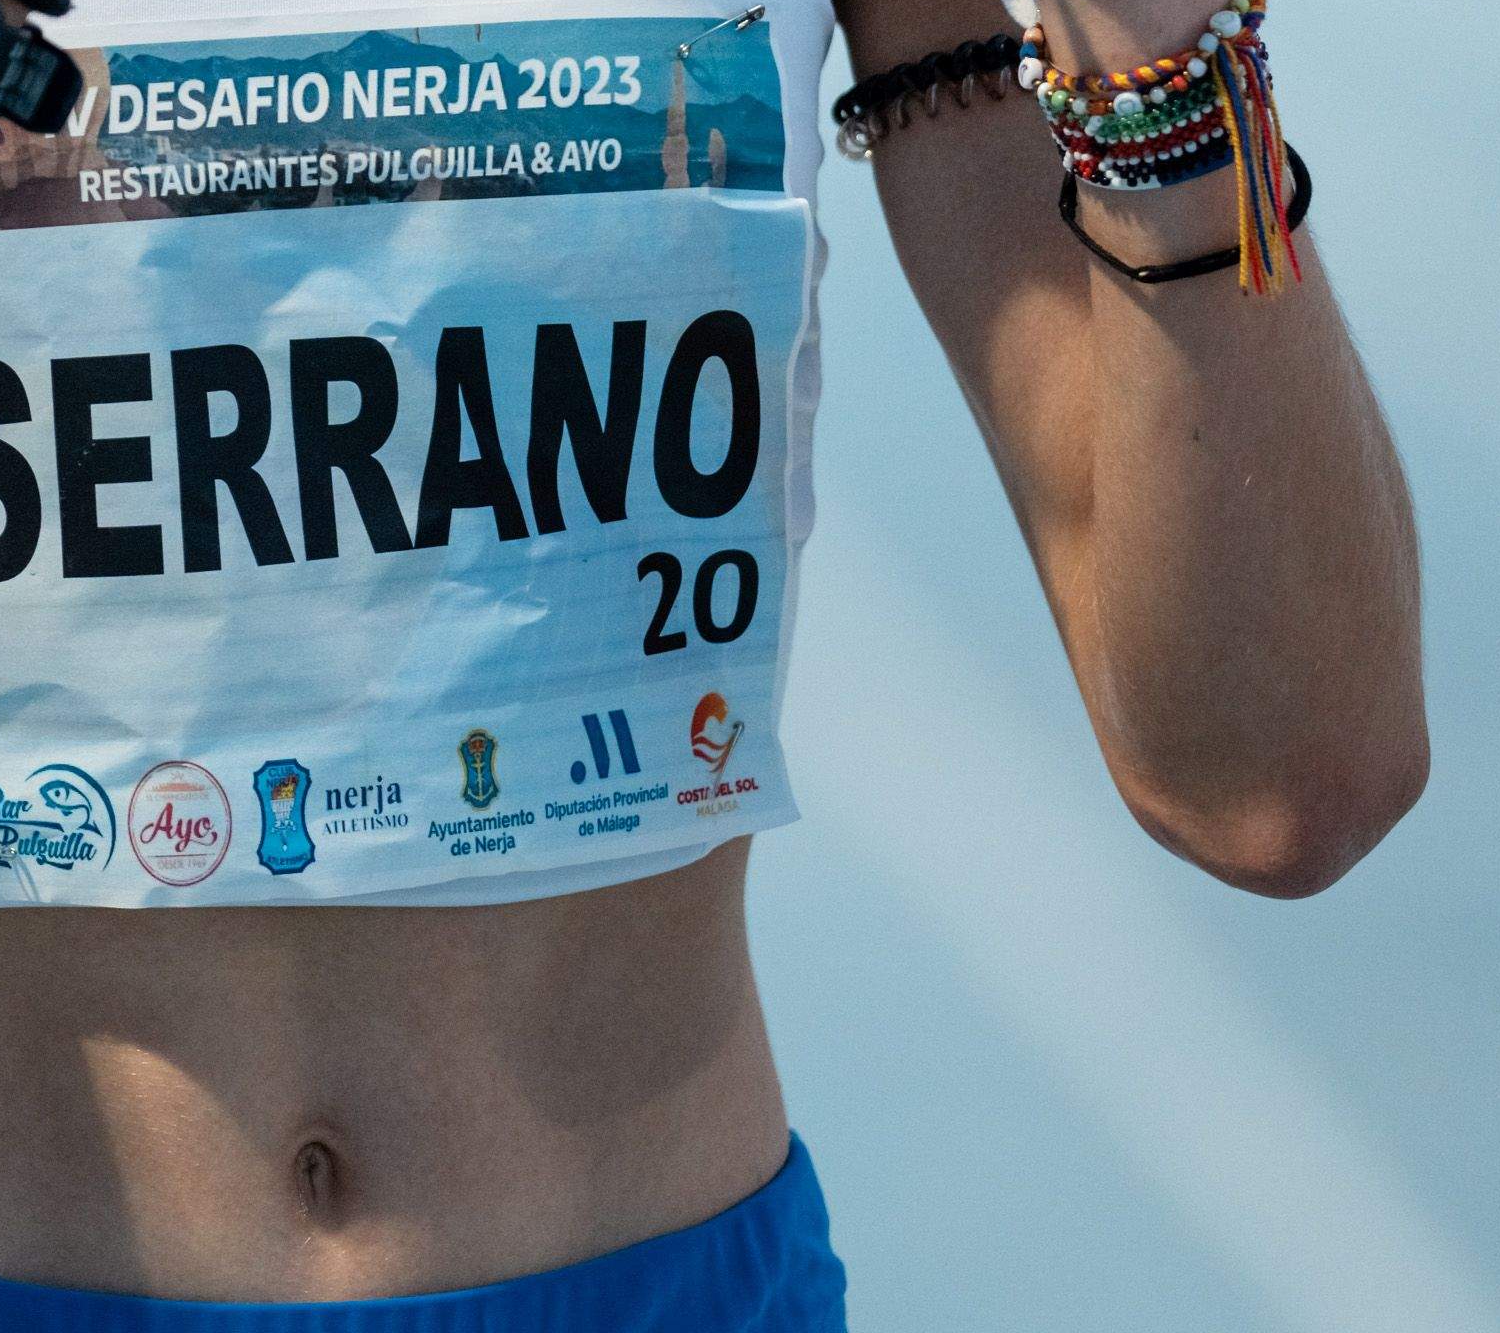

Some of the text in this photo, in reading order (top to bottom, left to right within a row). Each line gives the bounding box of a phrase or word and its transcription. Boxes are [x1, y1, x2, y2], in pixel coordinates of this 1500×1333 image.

[107, 71, 331, 134] DESAFIO
[342, 61, 508, 120] NERJA
[517, 55, 642, 109] 2023
[79, 137, 623, 203] RESTAURANTES PULGUILLA & AYO
[636, 549, 760, 656] 20
[325, 775, 402, 815] nerja
[545, 782, 669, 822] Diputación Provincial
[735, 776, 759, 793] SOL
[323, 813, 409, 835] ATLETISMO
[427, 810, 535, 840] Ayuntamiento
[578, 813, 641, 837] de Málaga
[450, 833, 517, 857] de Nerja
